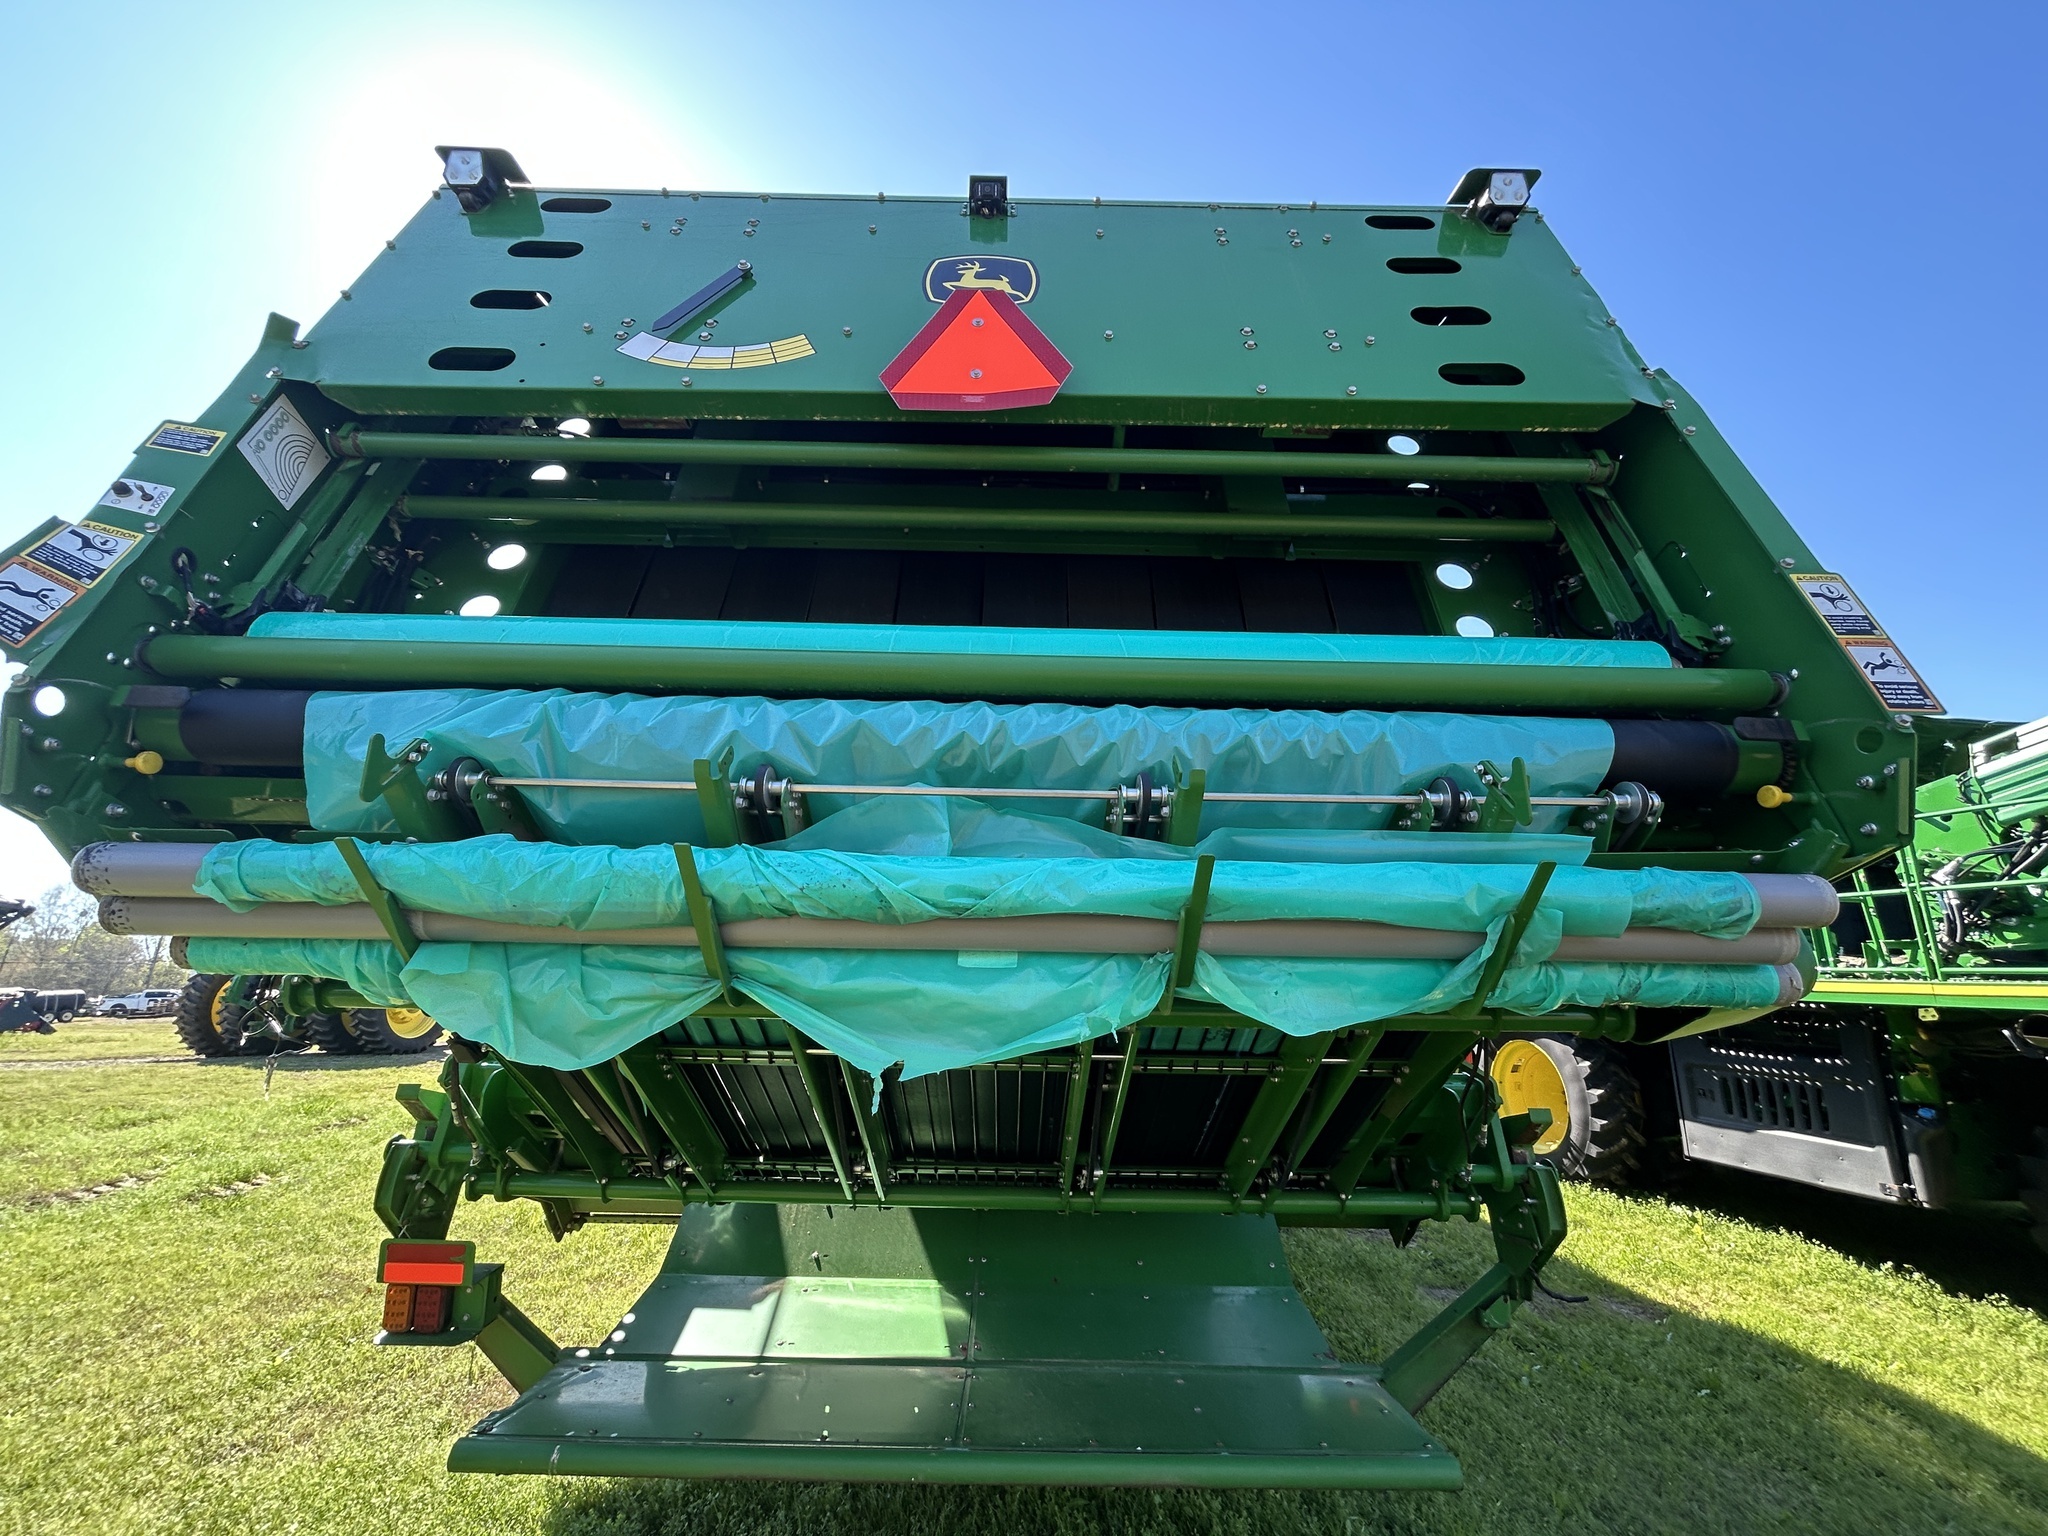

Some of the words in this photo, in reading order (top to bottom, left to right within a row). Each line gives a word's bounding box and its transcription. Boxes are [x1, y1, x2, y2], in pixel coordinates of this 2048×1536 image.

[183, 426, 217, 435] CAUTION
[92, 524, 139, 539] CAUTION
[32, 566, 79, 591] WARNING
